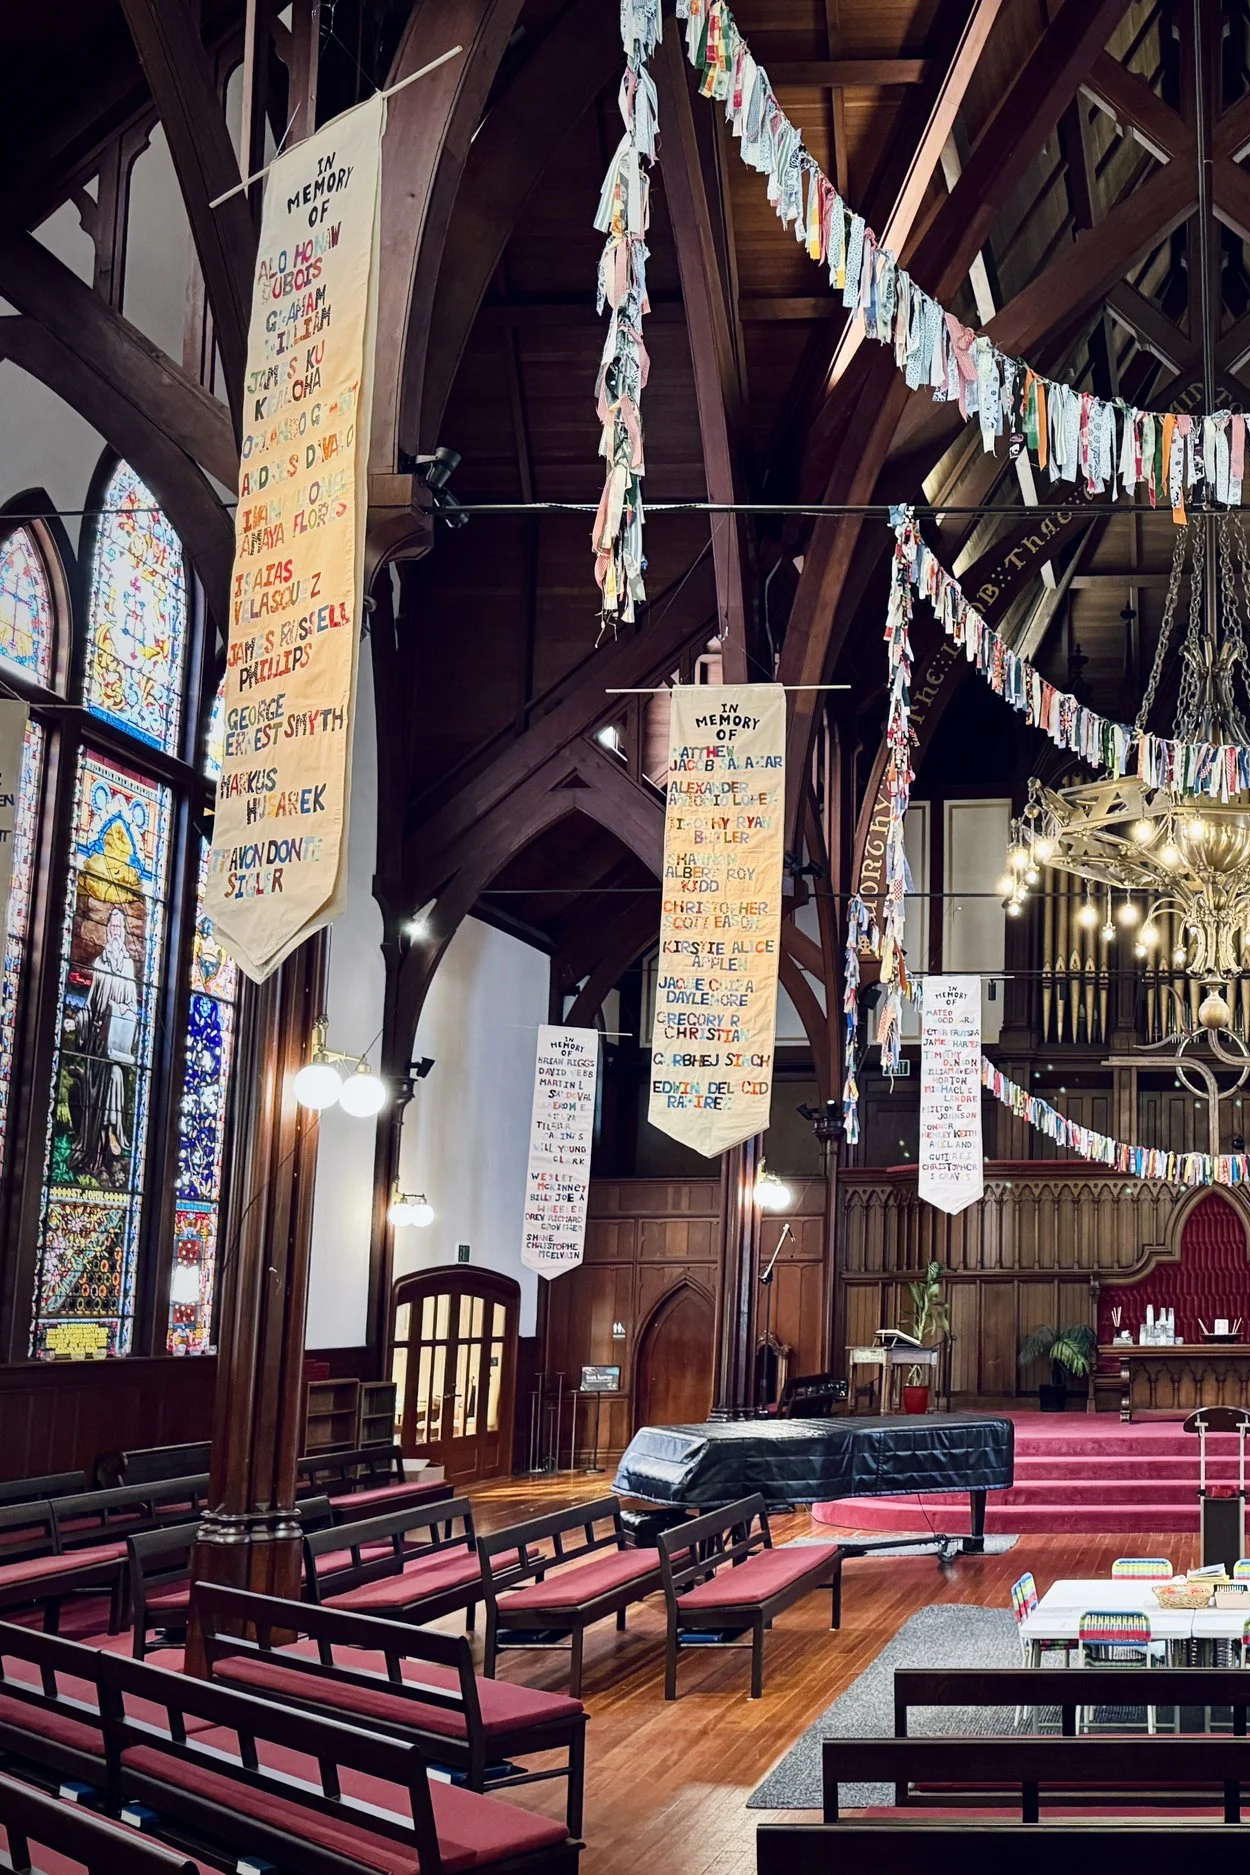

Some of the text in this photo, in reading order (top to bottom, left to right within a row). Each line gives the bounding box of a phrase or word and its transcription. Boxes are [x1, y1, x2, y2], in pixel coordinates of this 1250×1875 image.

[318, 152, 336, 177] IN
[287, 166, 354, 214] MEMORY
[308, 199, 330, 227] OF
[258, 250, 287, 284] ALO
[247, 340, 325, 394] JAMES KU
[235, 559, 293, 598] ISAIAS
[228, 631, 274, 667] JAMES
[240, 643, 312, 692] PHILLIPS
[228, 693, 286, 731] GEORGE
[721, 704, 738, 713] IN
[284, 705, 344, 738] SMYTH
[696, 714, 760, 730] MEMORY
[716, 729, 737, 740] OF
[220, 768, 278, 799] MARKUS
[669, 781, 748, 794] ALEXANDER
[681, 880, 719, 892] KIDD
[726, 868, 756, 880] ROY
[656, 1011, 740, 1026] GREGORY R
[664, 1026, 749, 1042] CHRISTIAN
[551, 1042, 584, 1053] MEMORY
[653, 1081, 768, 1095] EDWIN DEL CID
